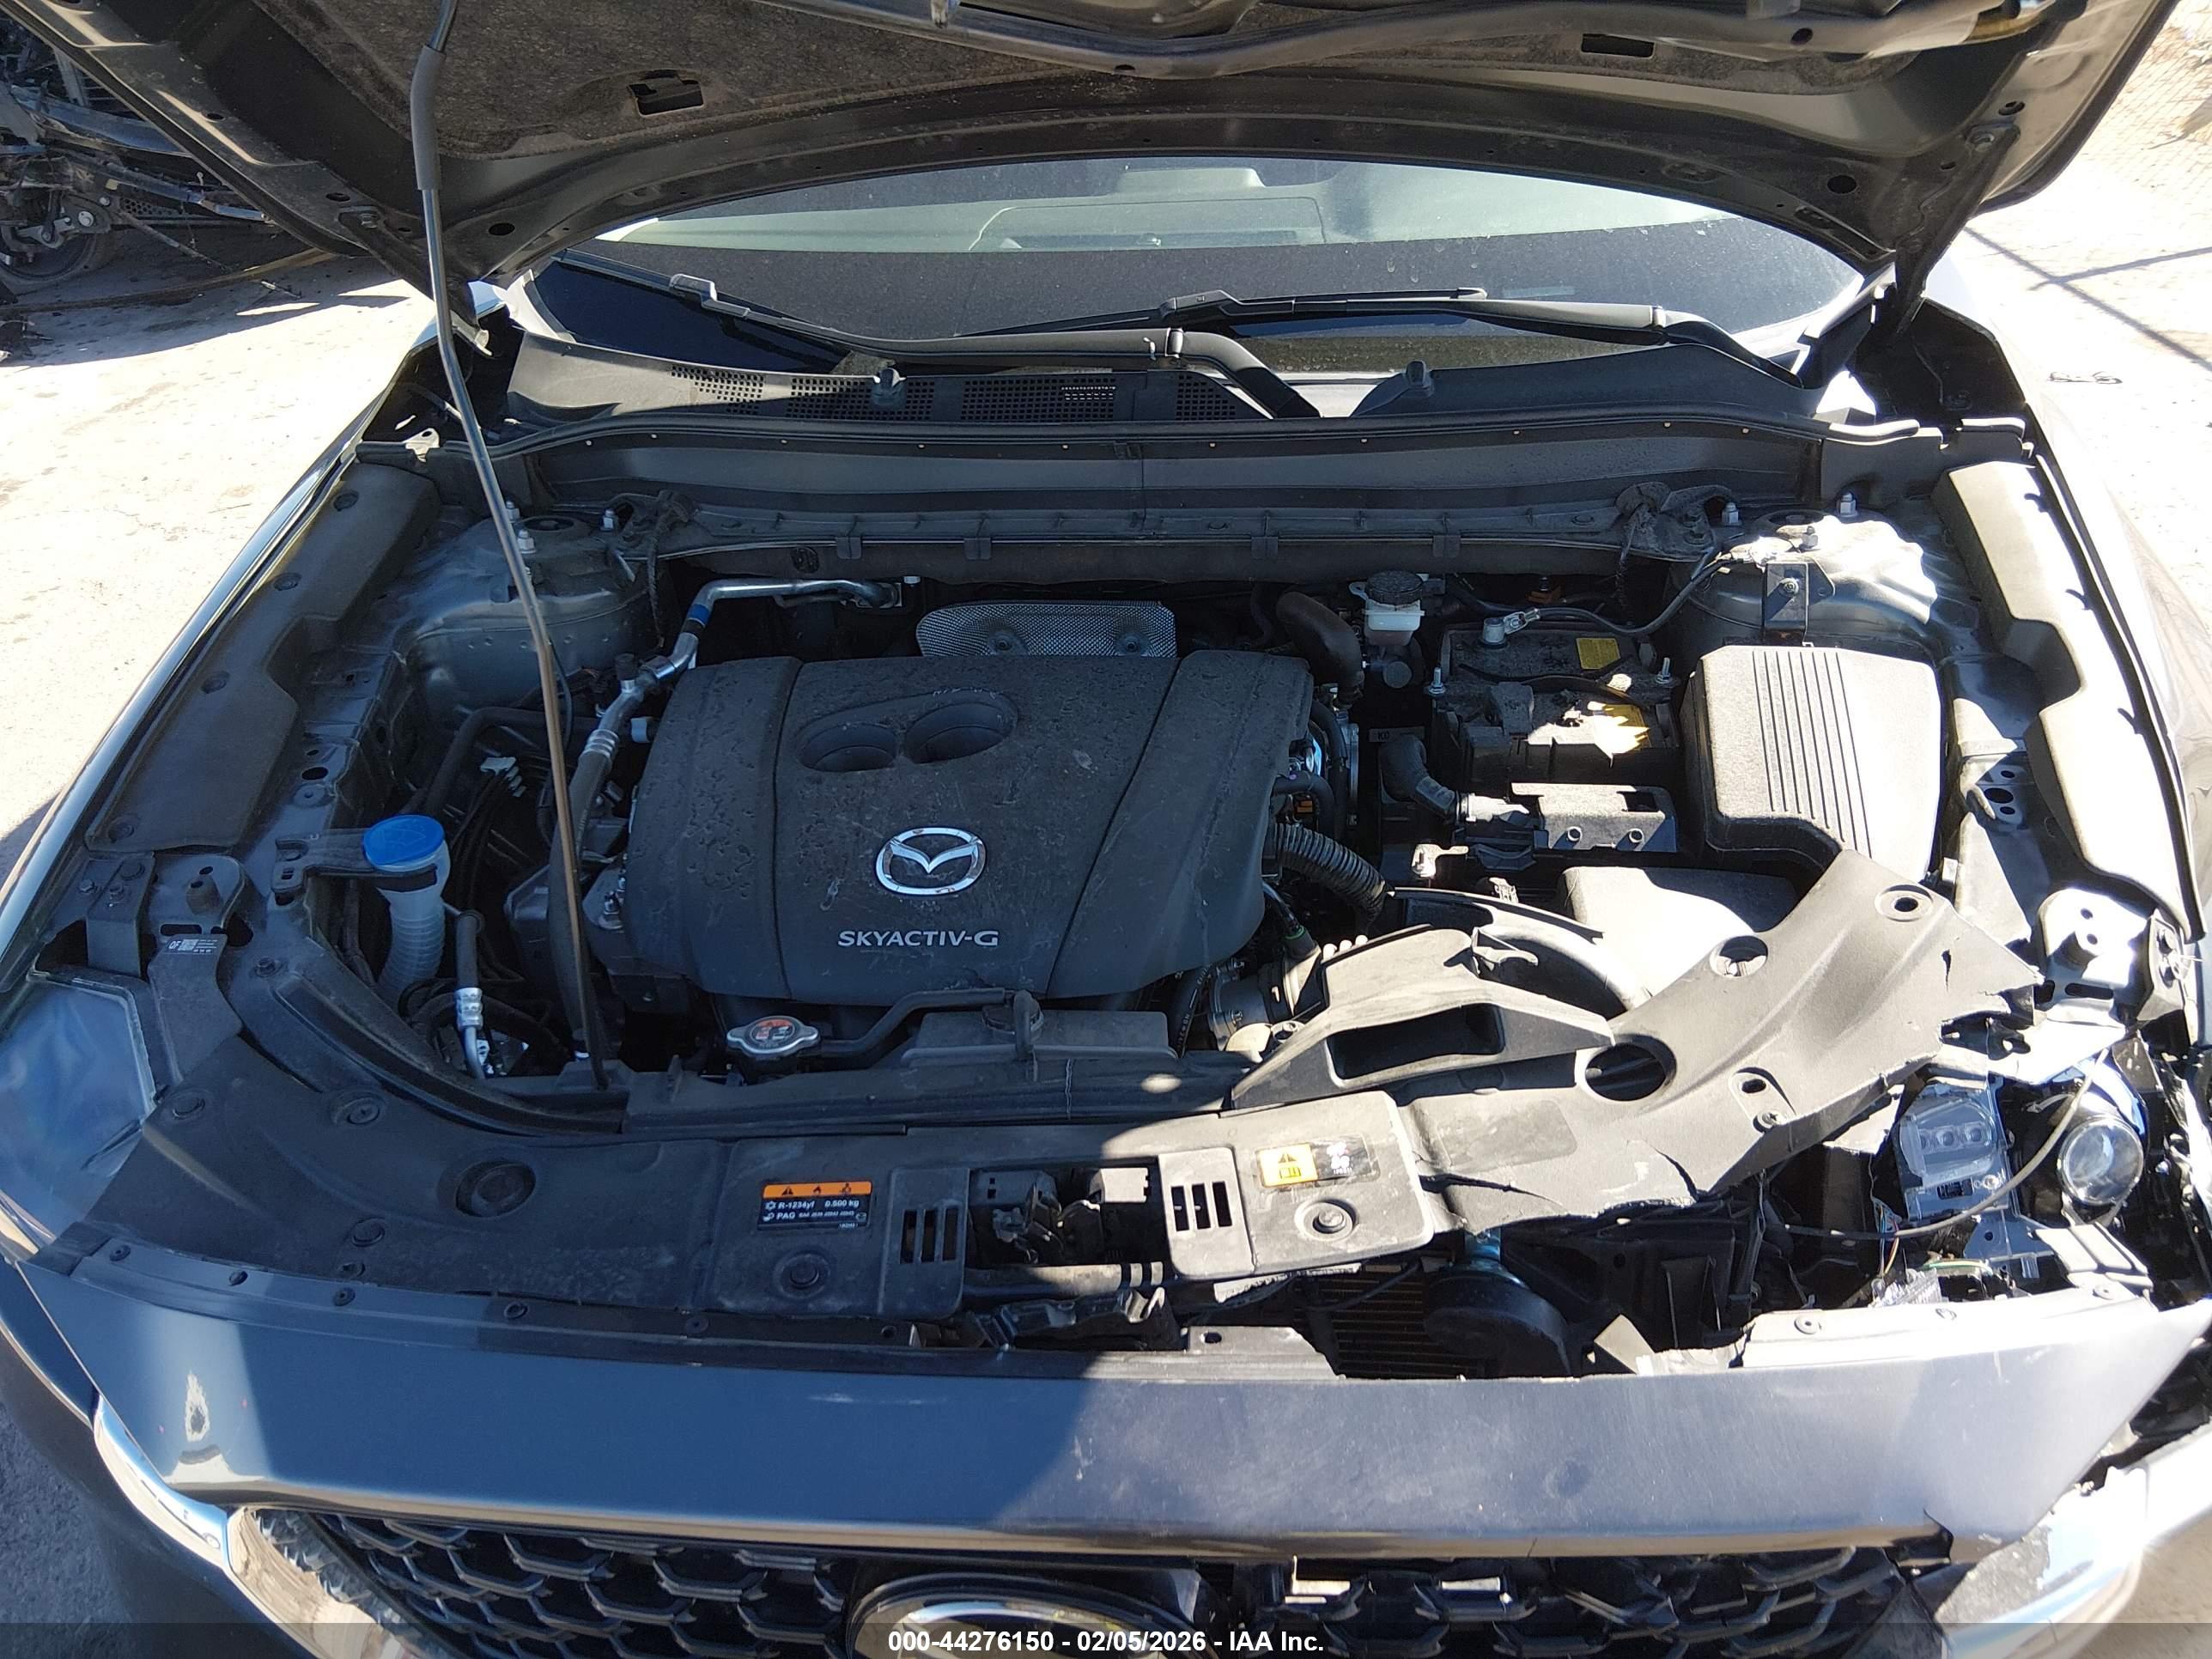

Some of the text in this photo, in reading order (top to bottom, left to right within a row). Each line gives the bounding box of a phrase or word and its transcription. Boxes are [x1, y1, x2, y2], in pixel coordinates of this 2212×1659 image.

[837, 930, 1000, 947] SKYACTIV-G
[778, 1200, 816, 1210] R-1234yf
[848, 1199, 860, 1208] kg
[776, 1212, 795, 1220] PAG
